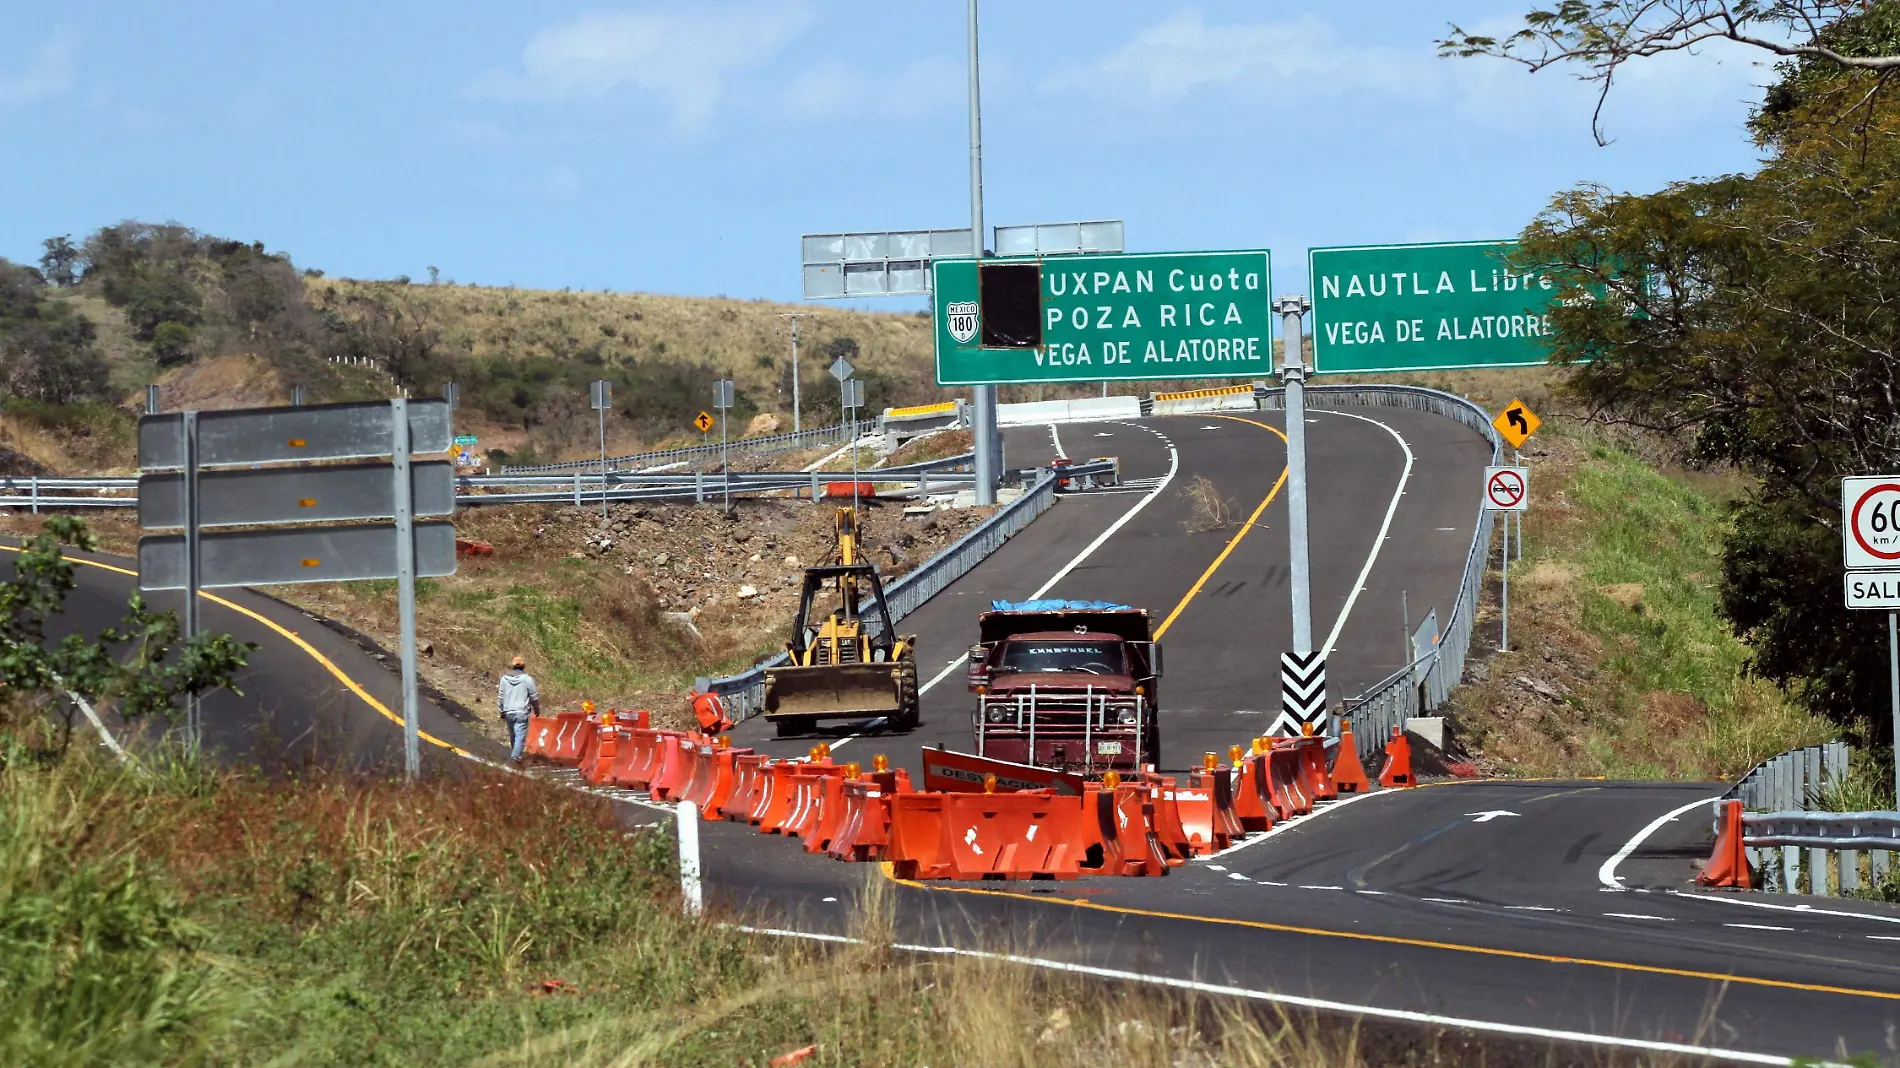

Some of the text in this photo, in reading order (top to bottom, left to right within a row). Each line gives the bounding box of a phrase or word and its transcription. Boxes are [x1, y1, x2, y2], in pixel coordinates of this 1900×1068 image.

[1041, 267, 1259, 296] UXPAN Cuota
[1322, 268, 1552, 299] NAUTLA Libre
[953, 315, 973, 332] 180
[1046, 302, 1243, 331] POZA RICA
[1324, 314, 1555, 346] VEGA DE ALATORRE
[1033, 337, 1261, 367] VEGA DE ALATORRE
